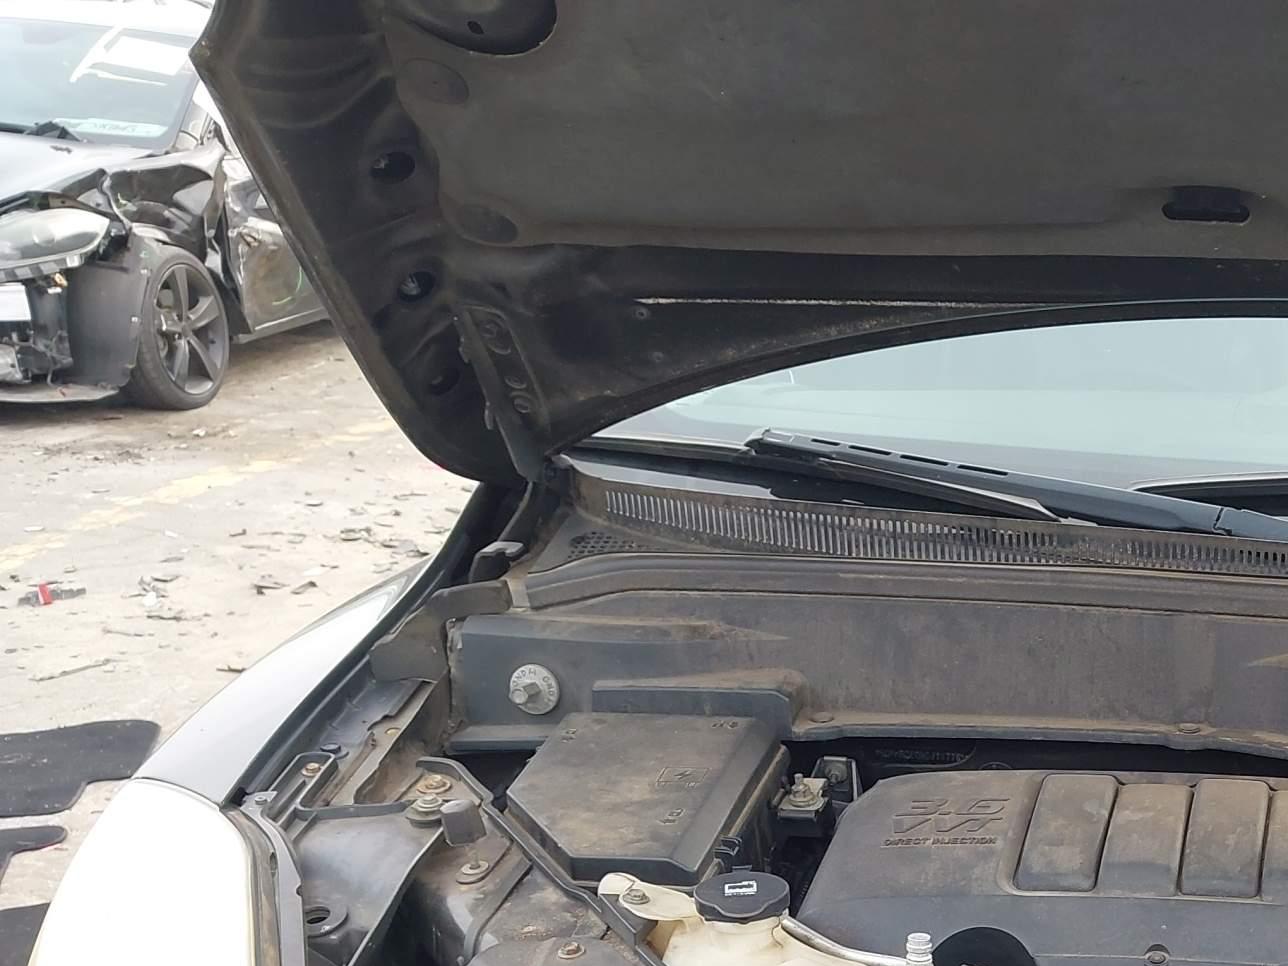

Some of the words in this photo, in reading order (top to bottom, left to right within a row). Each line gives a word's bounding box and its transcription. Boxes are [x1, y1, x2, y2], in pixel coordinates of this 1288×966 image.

[894, 798, 1010, 817] 3.6
[892, 817, 1004, 834] VVT
[883, 837, 931, 847] DIRECT
[932, 836, 998, 846] INJECTION
